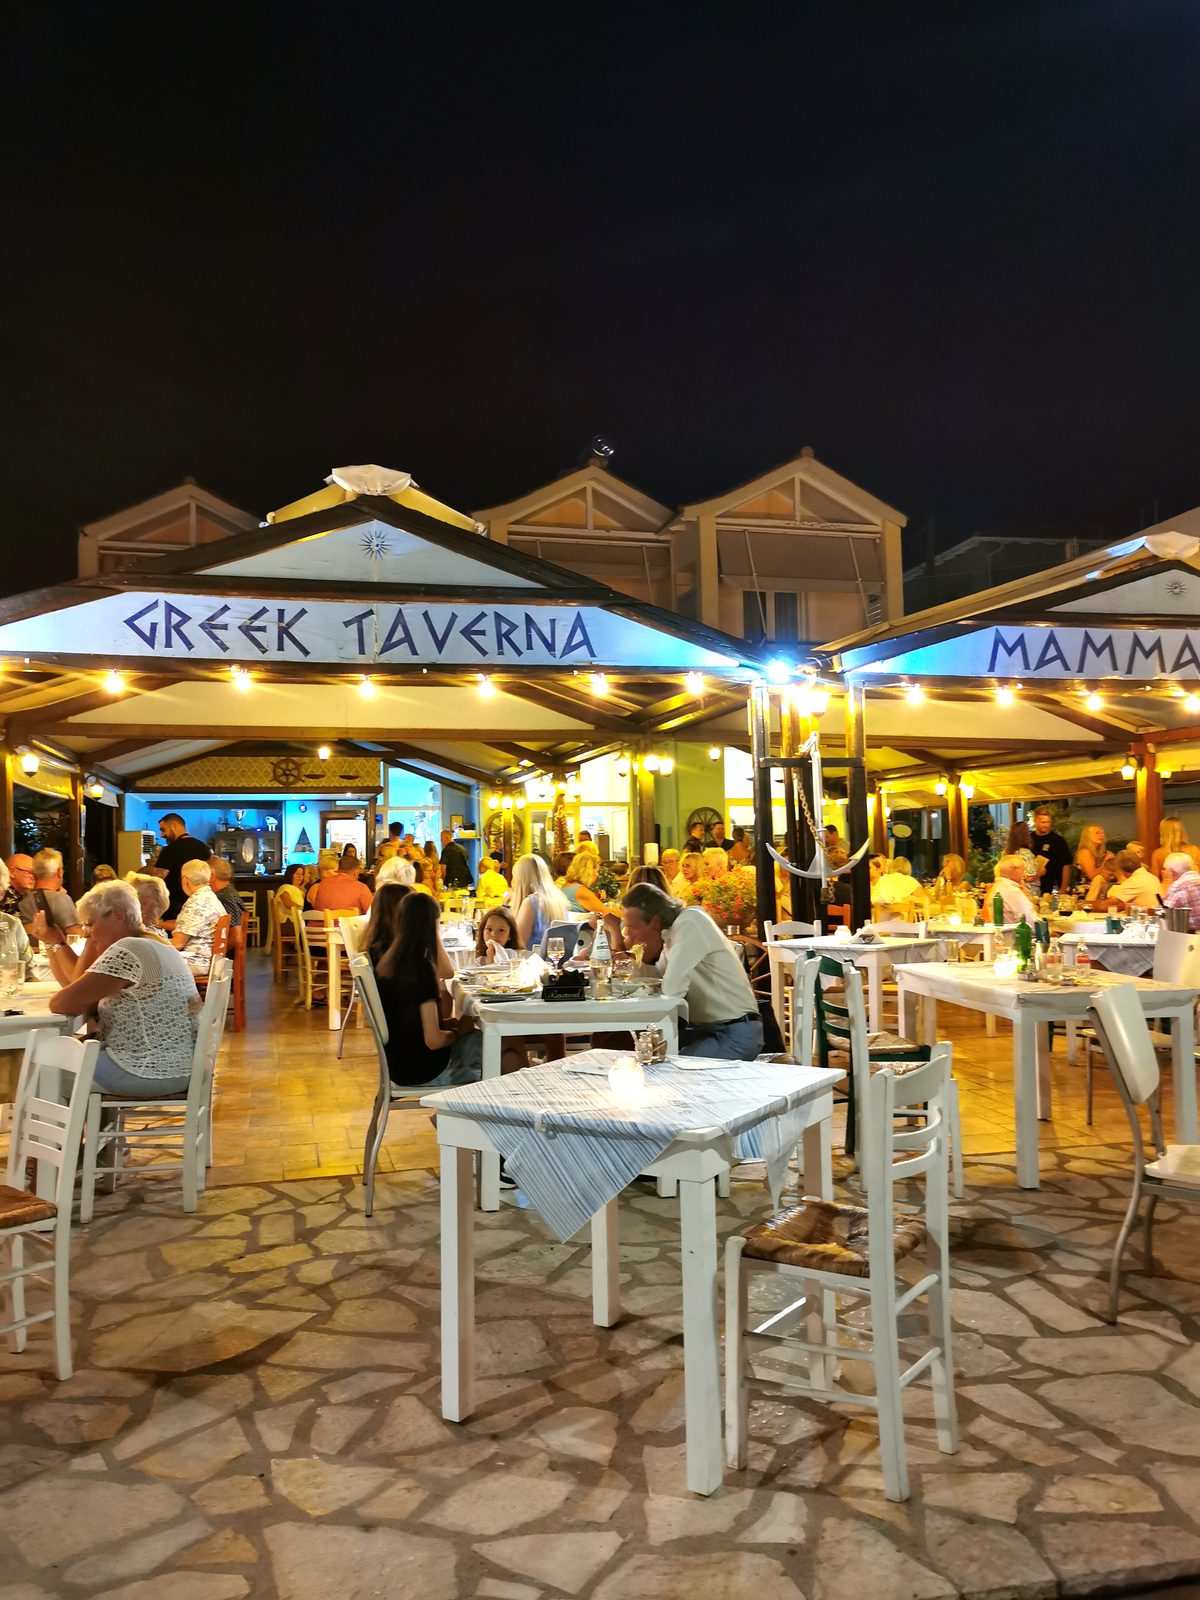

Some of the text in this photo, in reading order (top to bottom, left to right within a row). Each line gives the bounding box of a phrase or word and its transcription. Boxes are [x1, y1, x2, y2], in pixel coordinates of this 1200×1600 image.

[122, 599, 597, 659] GREEK TAVERNA
[987, 628, 1200, 675] MAMMA
